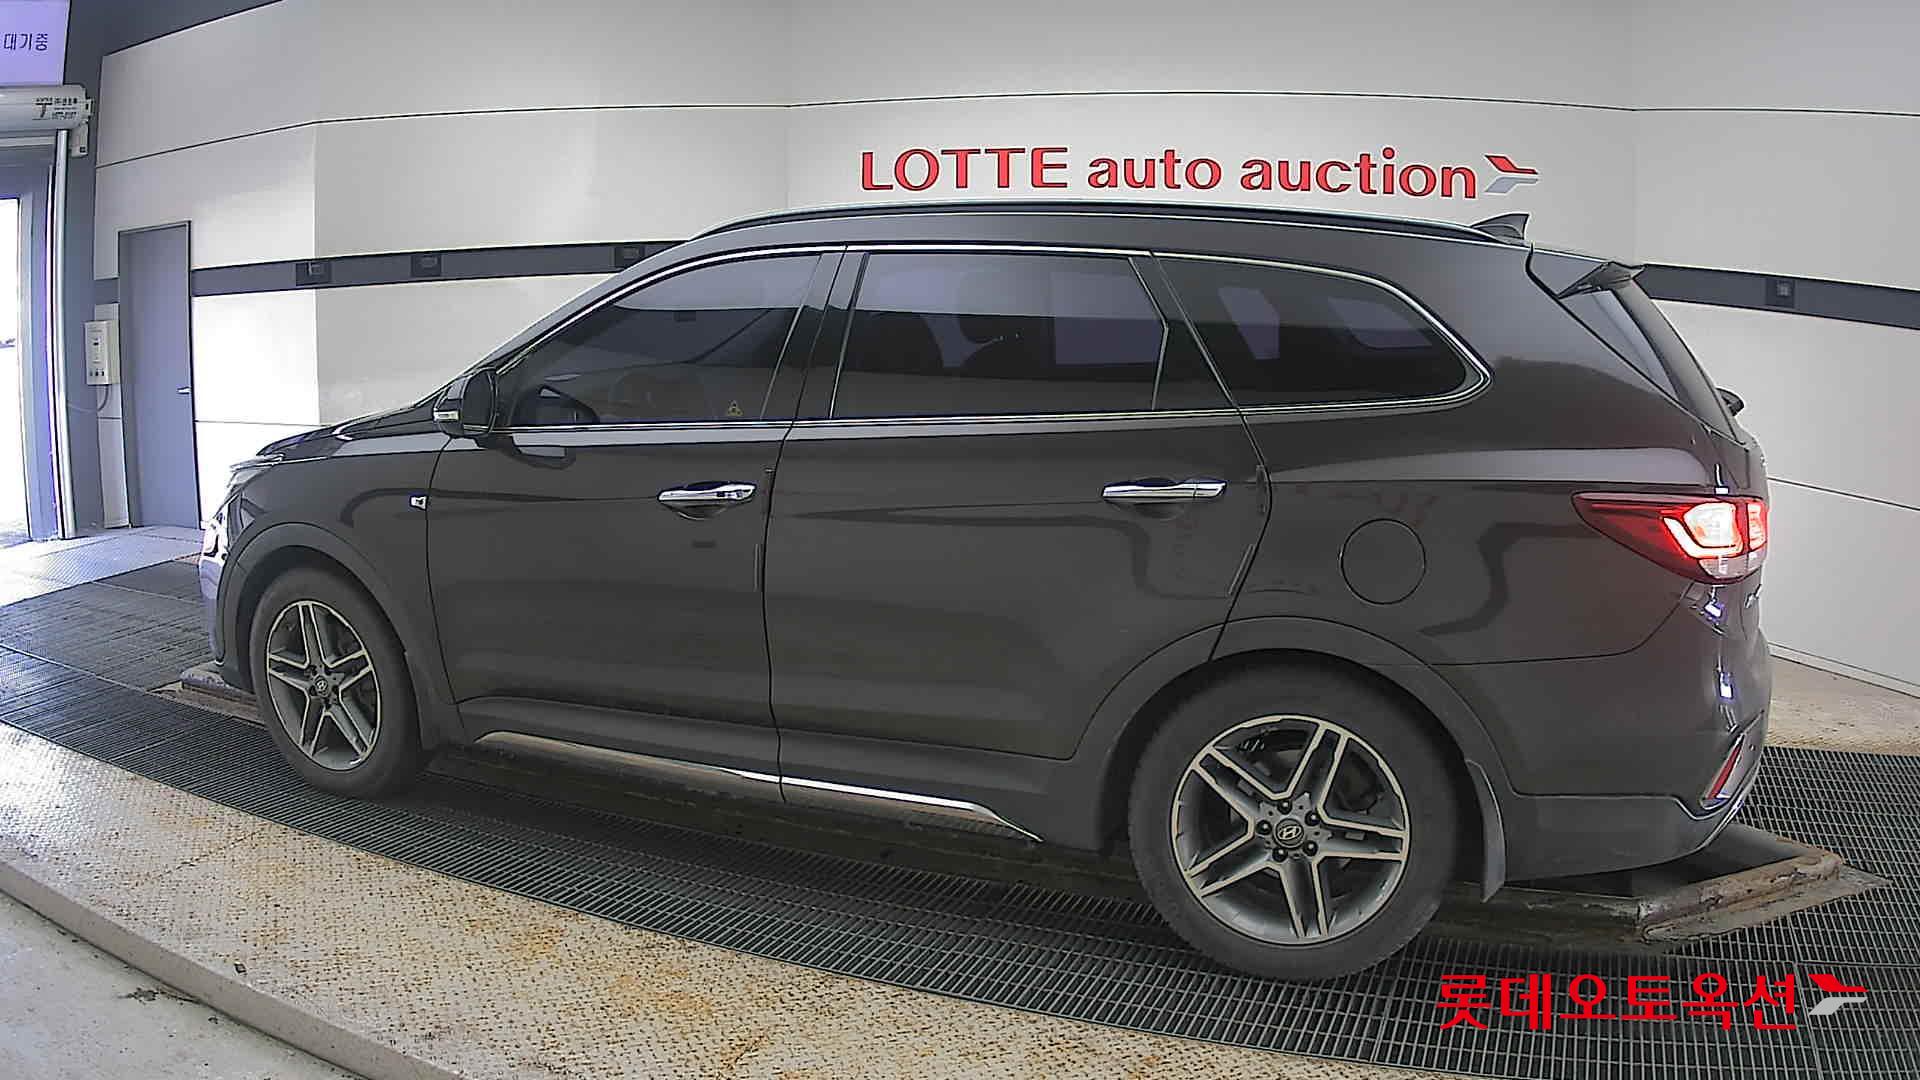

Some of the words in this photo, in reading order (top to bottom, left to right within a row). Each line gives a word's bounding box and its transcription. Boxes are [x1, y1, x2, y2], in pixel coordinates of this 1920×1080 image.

[3, 33, 49, 52] 대기중
[862, 147, 1067, 191] LOTTE
[1087, 149, 1223, 190] auto
[1240, 147, 1477, 198] auction
